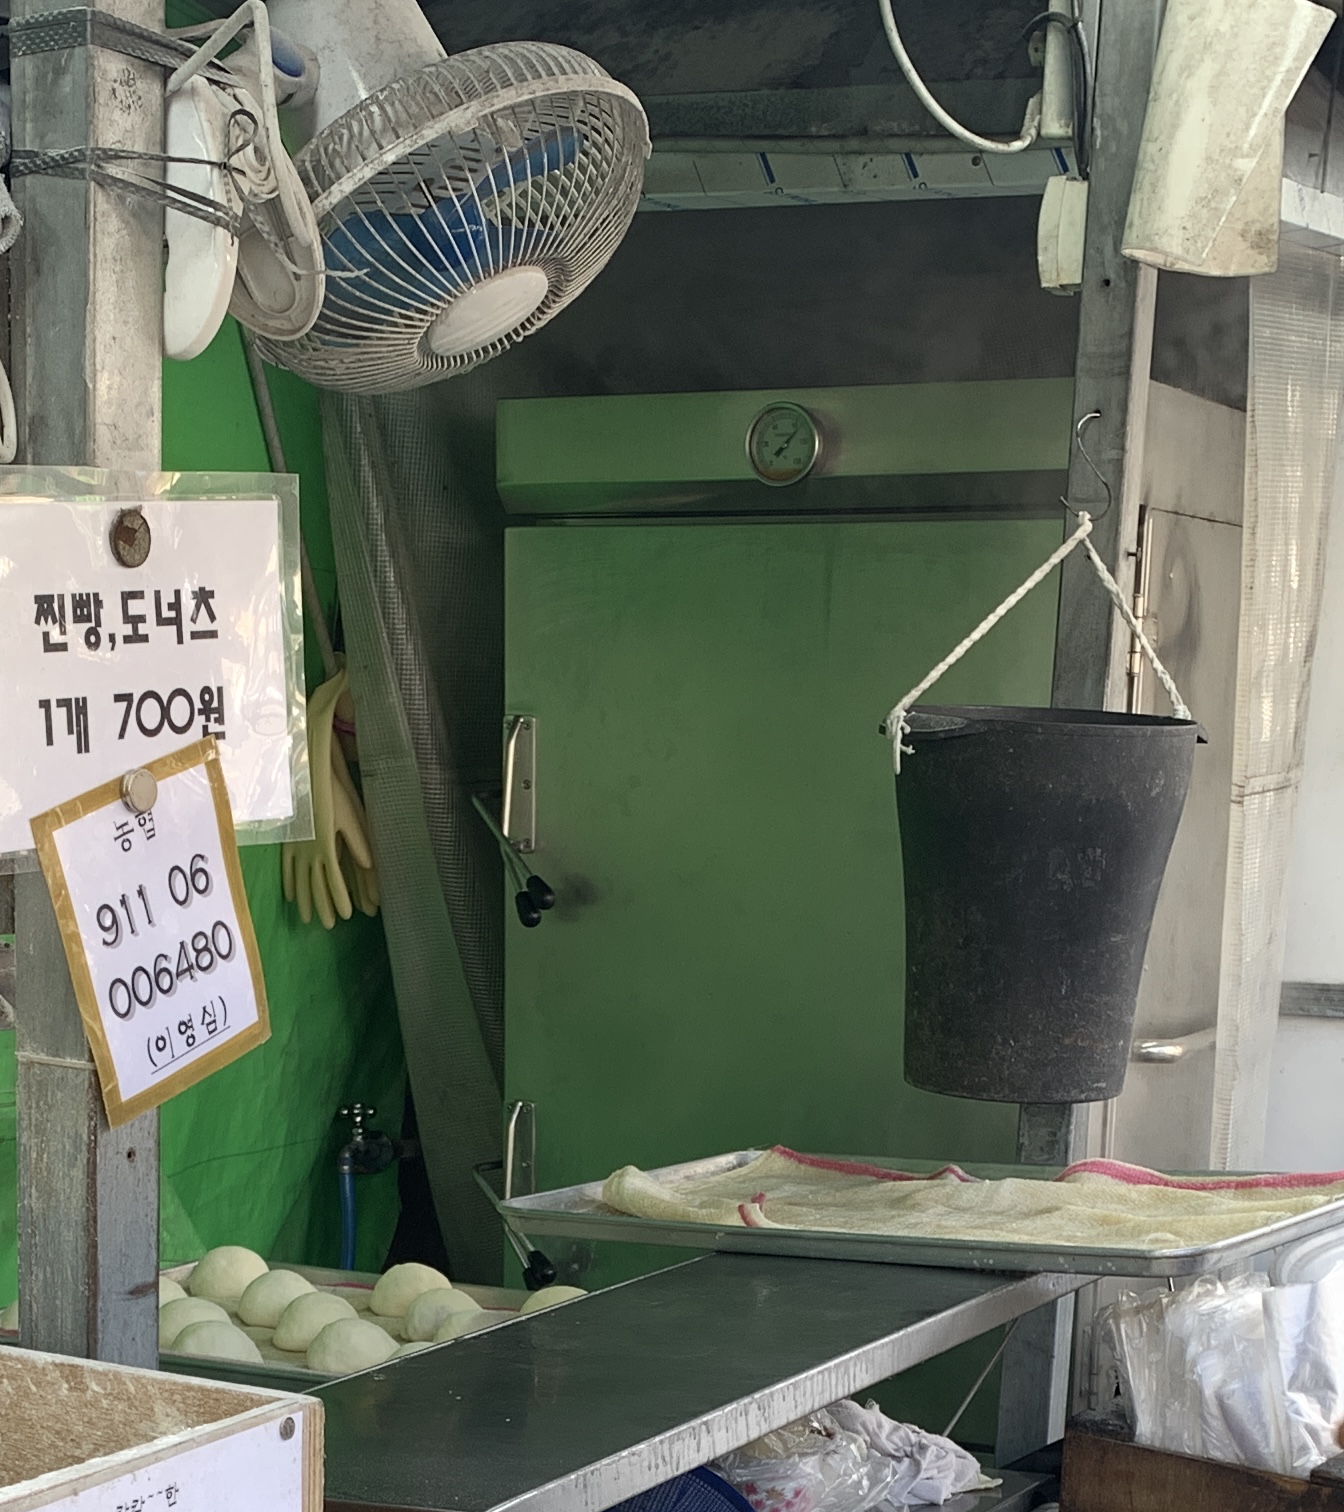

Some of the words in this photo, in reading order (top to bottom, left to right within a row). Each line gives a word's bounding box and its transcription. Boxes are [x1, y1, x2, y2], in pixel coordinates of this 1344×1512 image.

[33, 586, 219, 653] 찐빵,도너츠
[38, 696, 90, 754] 1개
[113, 685, 226, 741] 700원
[96, 884, 156, 948] 911
[168, 853, 211, 908] 06
[109, 920, 235, 1020] 006480
[147, 995, 228, 1067] (이영심)
